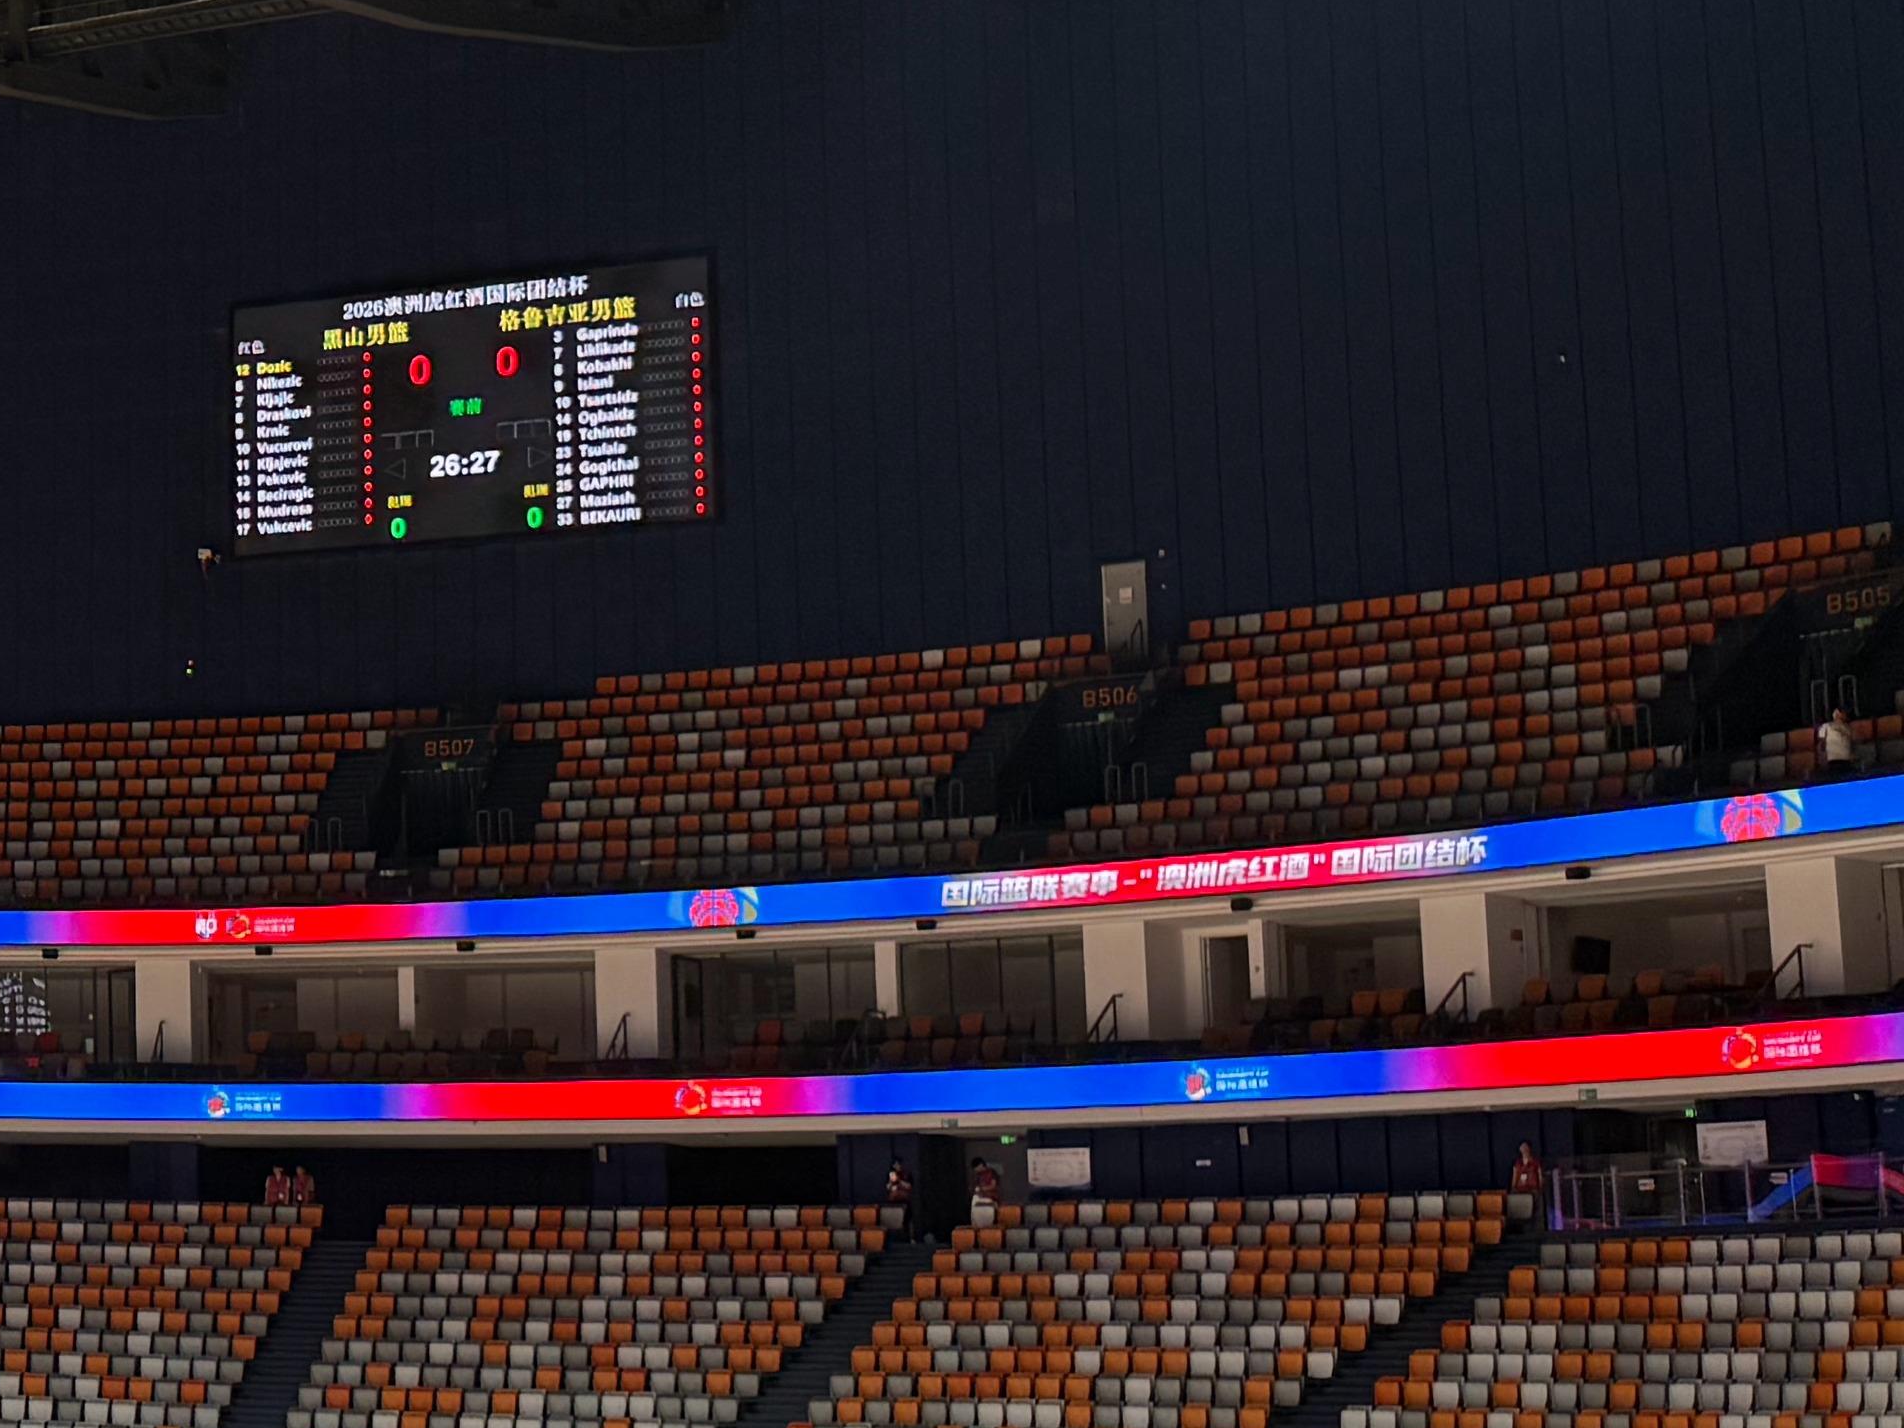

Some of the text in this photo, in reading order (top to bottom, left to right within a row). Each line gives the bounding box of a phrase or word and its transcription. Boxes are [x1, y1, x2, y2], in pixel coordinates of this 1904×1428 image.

[343, 275, 589, 320] 2026澳洲虎红酒国际团结杯
[499, 296, 637, 332] 格鲁吉亚男篮
[409, 354, 432, 386] 0
[496, 346, 518, 376] 0
[430, 450, 501, 478] 26:27
[391, 517, 407, 539] 0
[527, 507, 542, 528] 0
[1827, 585, 1892, 615] B505
[1083, 687, 1138, 709] B506
[425, 739, 476, 758] B507
